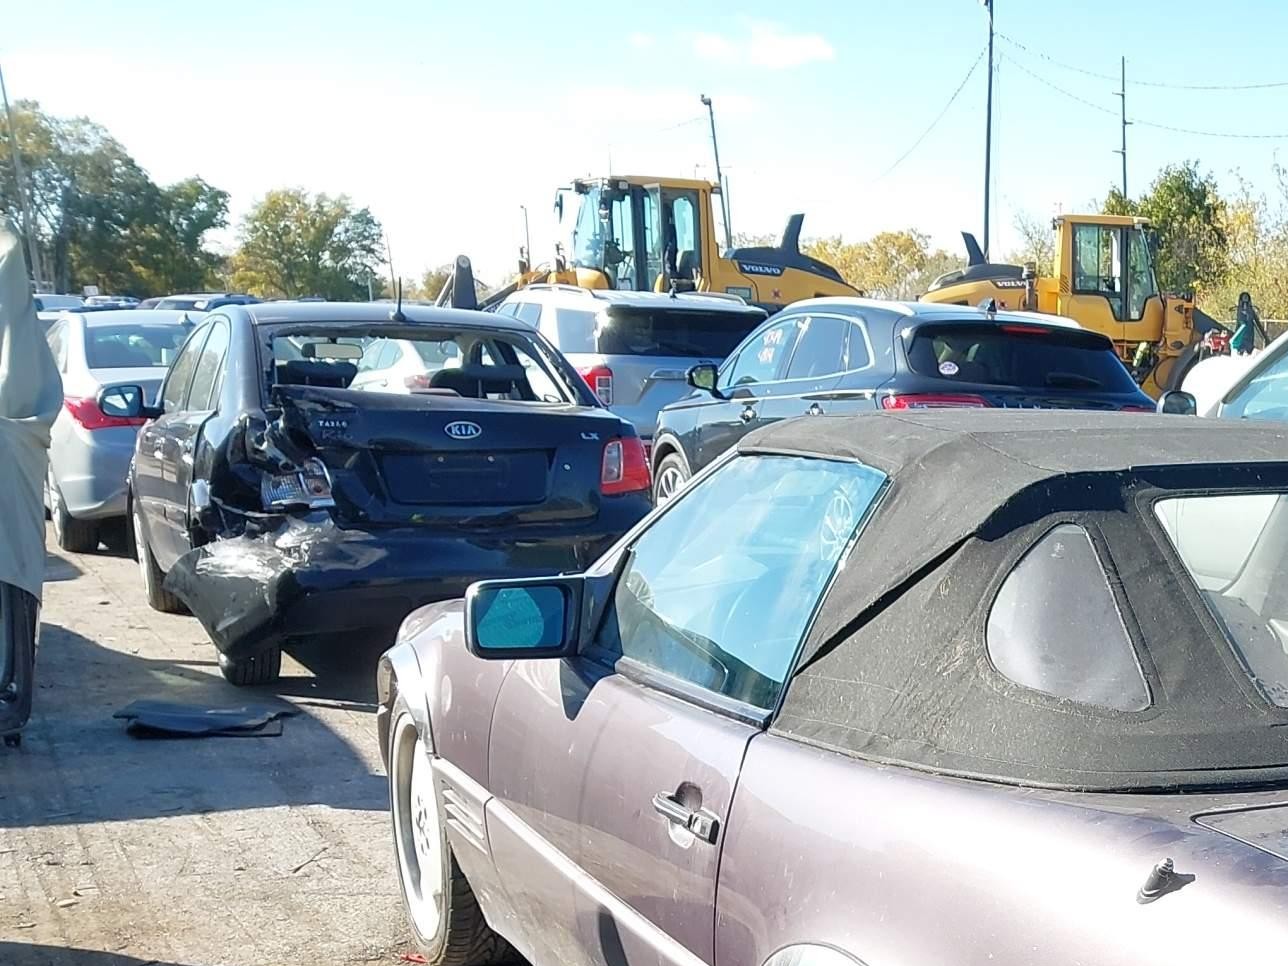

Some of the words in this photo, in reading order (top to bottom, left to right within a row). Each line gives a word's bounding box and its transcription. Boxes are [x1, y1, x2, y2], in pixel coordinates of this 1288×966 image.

[742, 264, 781, 275] VOLVO
[448, 423, 479, 437] KIA
[580, 432, 600, 440] LX
